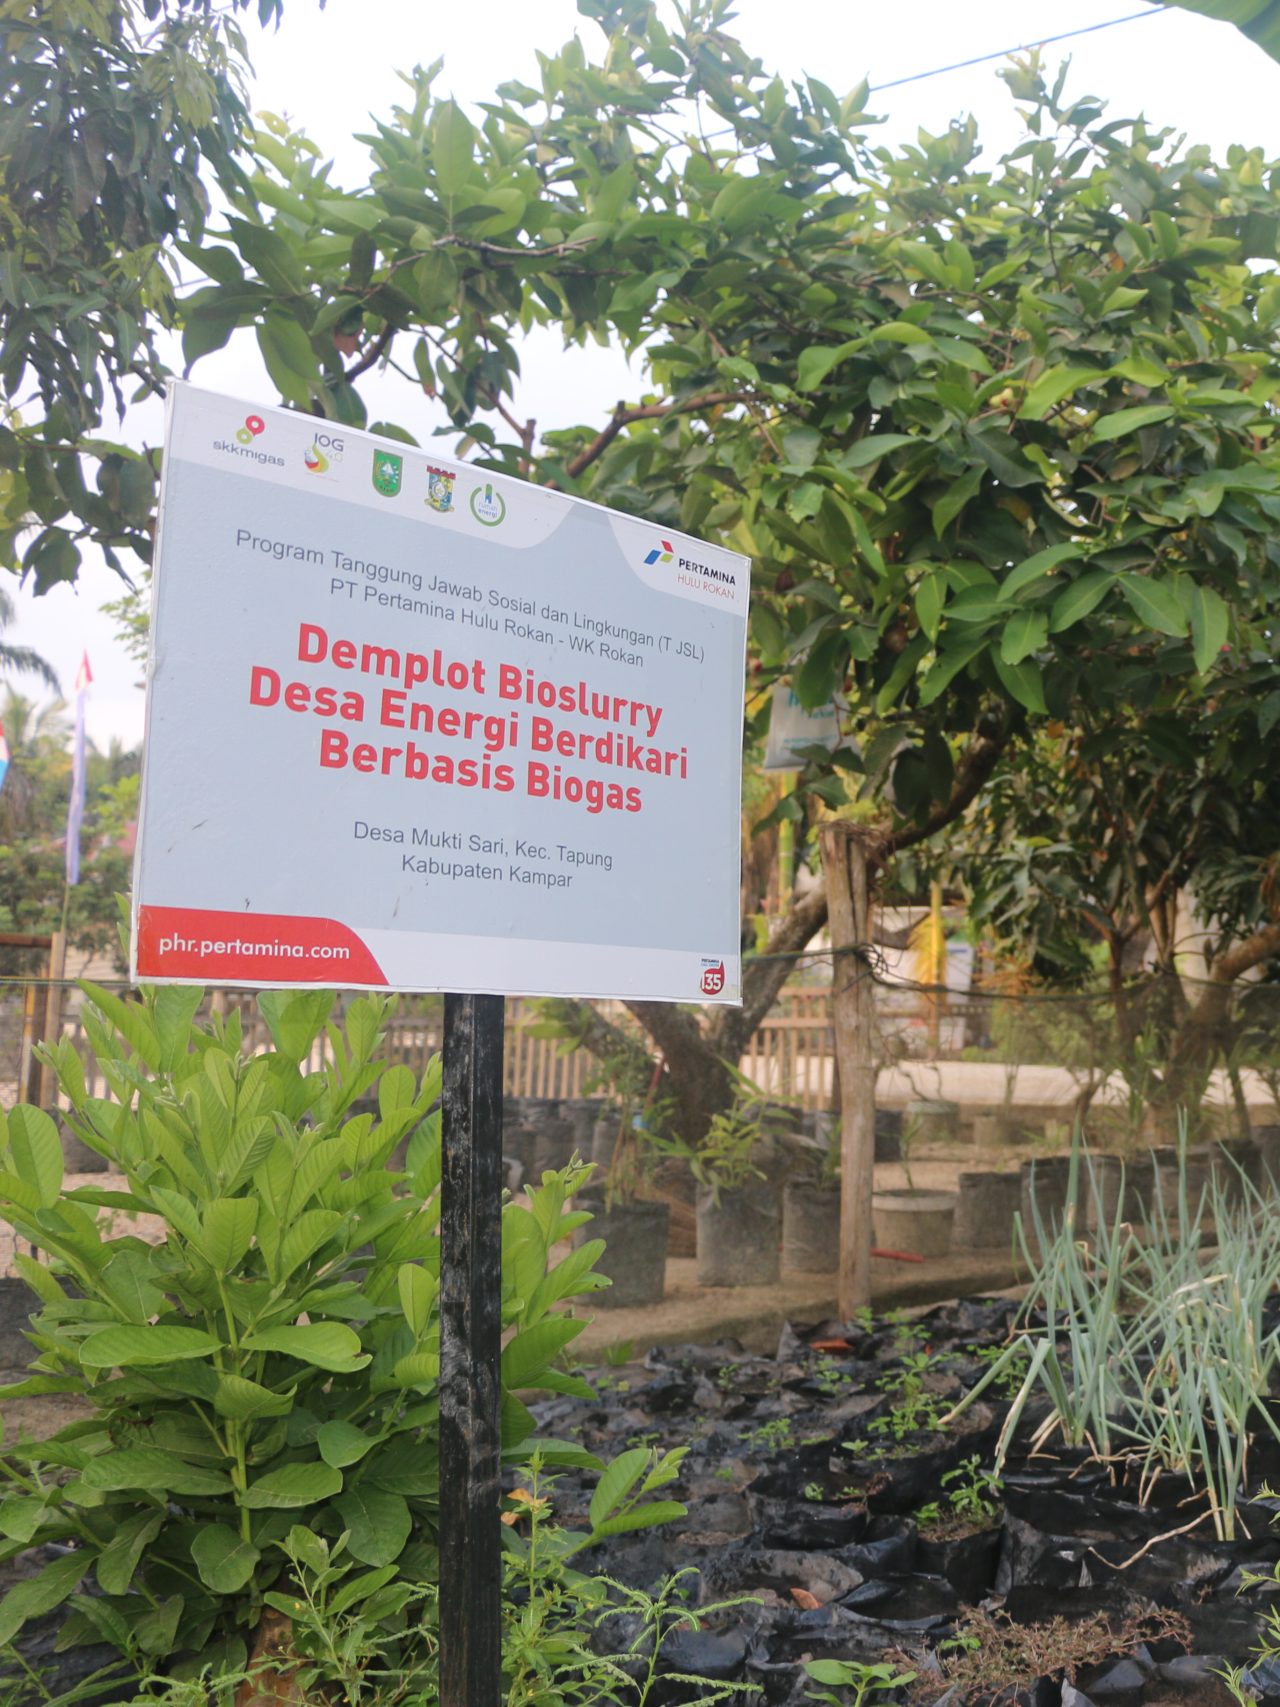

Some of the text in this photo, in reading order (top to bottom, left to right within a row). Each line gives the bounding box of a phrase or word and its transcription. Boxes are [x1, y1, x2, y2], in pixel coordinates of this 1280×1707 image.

[213, 440, 286, 467] skkmigas
[478, 508, 498, 519] energi
[236, 528, 325, 566] Program
[331, 550, 423, 591] Tanggung
[428, 575, 483, 602] Jawab
[488, 589, 536, 616] Sosial
[541, 604, 569, 625] dan
[574, 611, 654, 647] Lingkungan
[677, 573, 736, 600] HULU ROKAN
[679, 558, 736, 586] PERTAMINA
[330, 577, 358, 599] PT
[364, 585, 455, 622] Pertamina
[461, 607, 499, 632] Hulu
[504, 618, 554, 645] Rokan
[569, 634, 595, 655] WK
[600, 642, 644, 668] Rokan
[298, 622, 663, 738] Demplot Bioslurry
[249, 665, 688, 780] Desa Energi Berdikari
[319, 728, 643, 815] Berbasis Biogas
[354, 821, 613, 872] Desa Mukti Sari, Kec. Tapung
[401, 854, 573, 890] Kabupaten Kampar
[159, 932, 351, 960] phr.pertamina.com
[701, 973, 722, 991] 135
